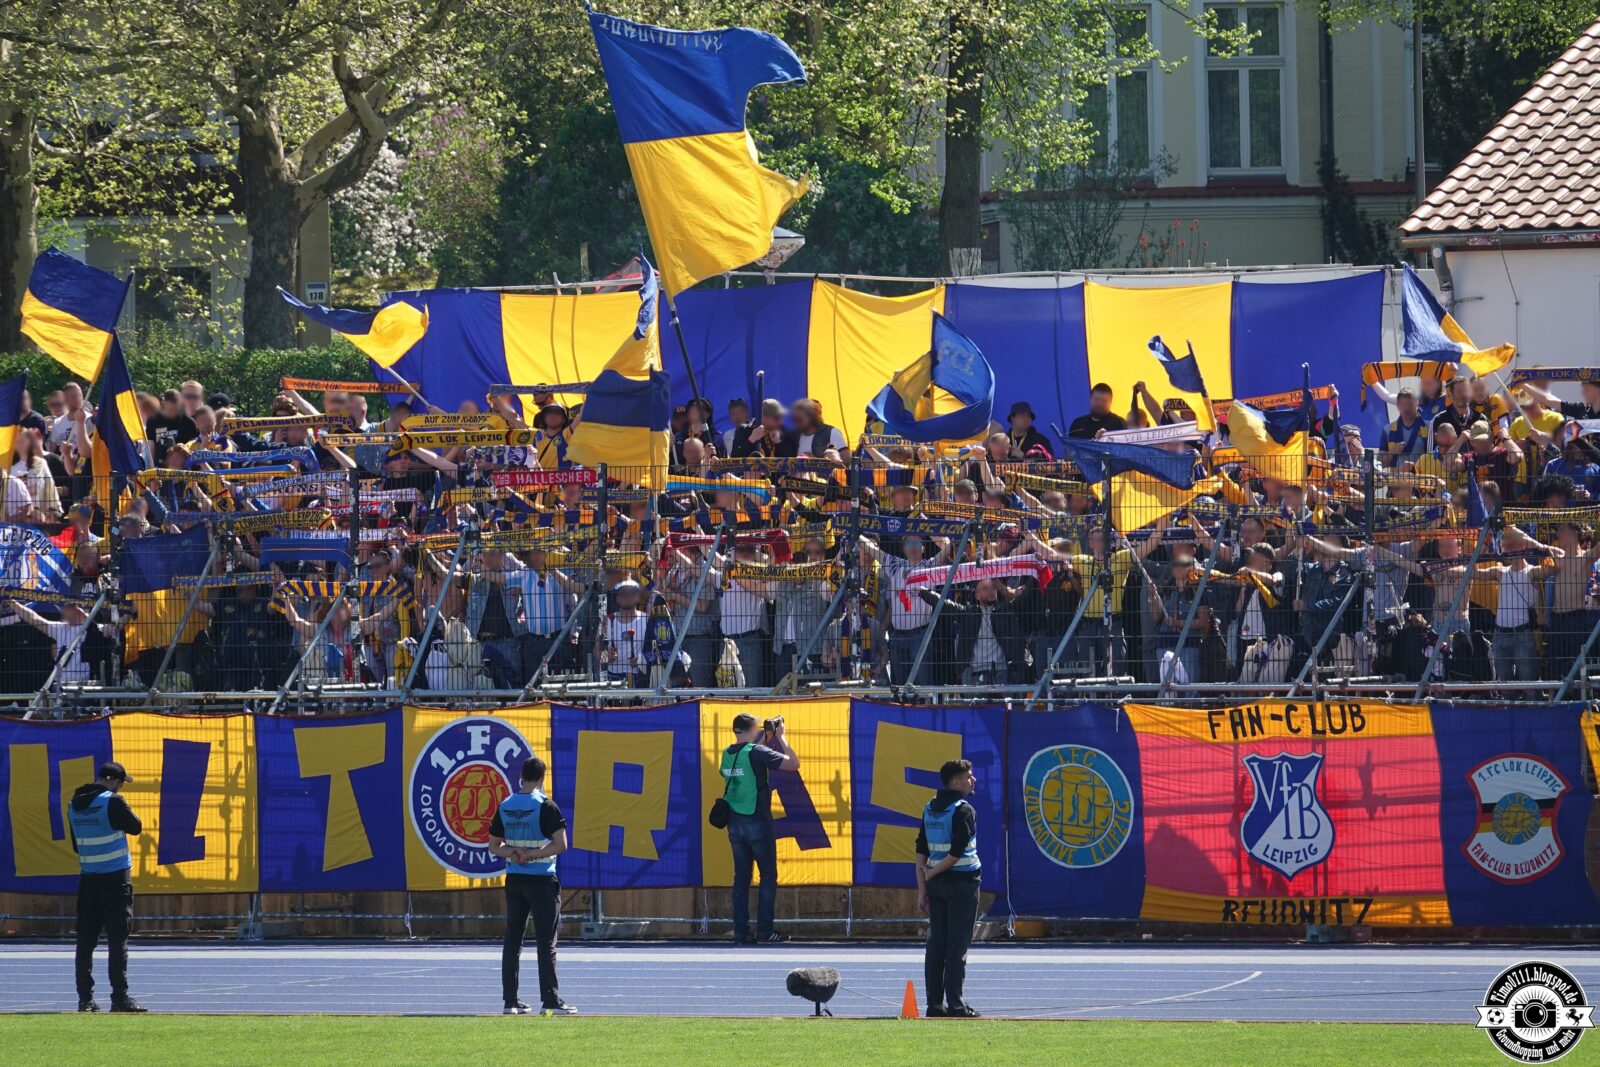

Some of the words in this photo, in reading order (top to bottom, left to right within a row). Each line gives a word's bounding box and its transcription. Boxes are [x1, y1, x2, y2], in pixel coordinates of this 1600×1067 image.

[439, 435, 458, 443] LOK
[464, 434, 503, 443] LEIPZIG
[515, 470, 592, 484] HALLESCHER
[2, 527, 53, 557] LEIPZIG
[1207, 702, 1367, 740] FAN-CLUB
[429, 724, 522, 775] 1.FC
[1052, 748, 1097, 768] 1.FC
[1478, 763, 1501, 783] 1.FC
[1502, 760, 1523, 773] LOK
[1525, 762, 1562, 793] LEIPZIG
[1250, 760, 1321, 841] VfB
[1025, 784, 1078, 865] LOKOMOTIVE
[1090, 799, 1131, 865] LEIPZIG
[1262, 843, 1319, 864] LEIPZIG
[1471, 842, 1511, 876] FAN-CLUB
[1514, 844, 1556, 877] REUDNITZ
